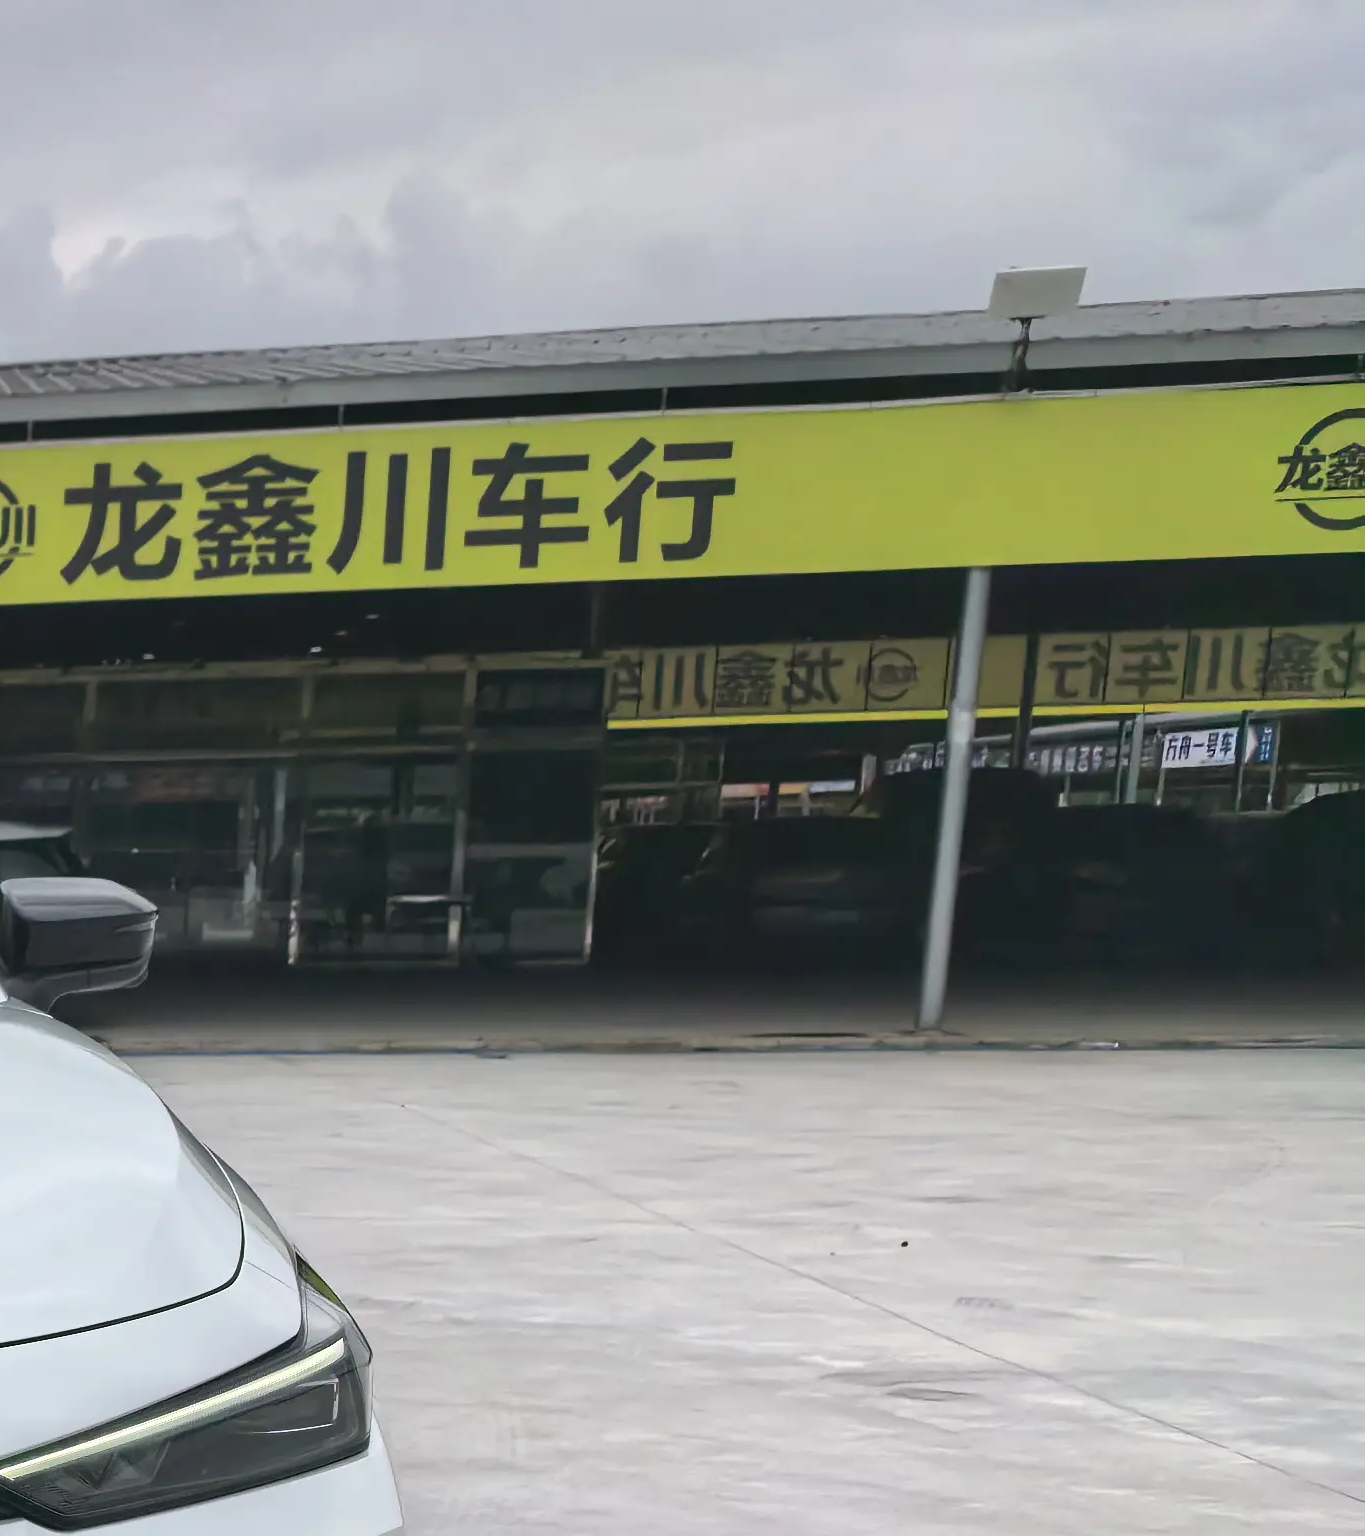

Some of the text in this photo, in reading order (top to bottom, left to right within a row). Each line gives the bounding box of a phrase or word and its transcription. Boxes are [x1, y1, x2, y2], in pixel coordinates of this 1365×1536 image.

[59, 436, 737, 586] 龙鑫川车行
